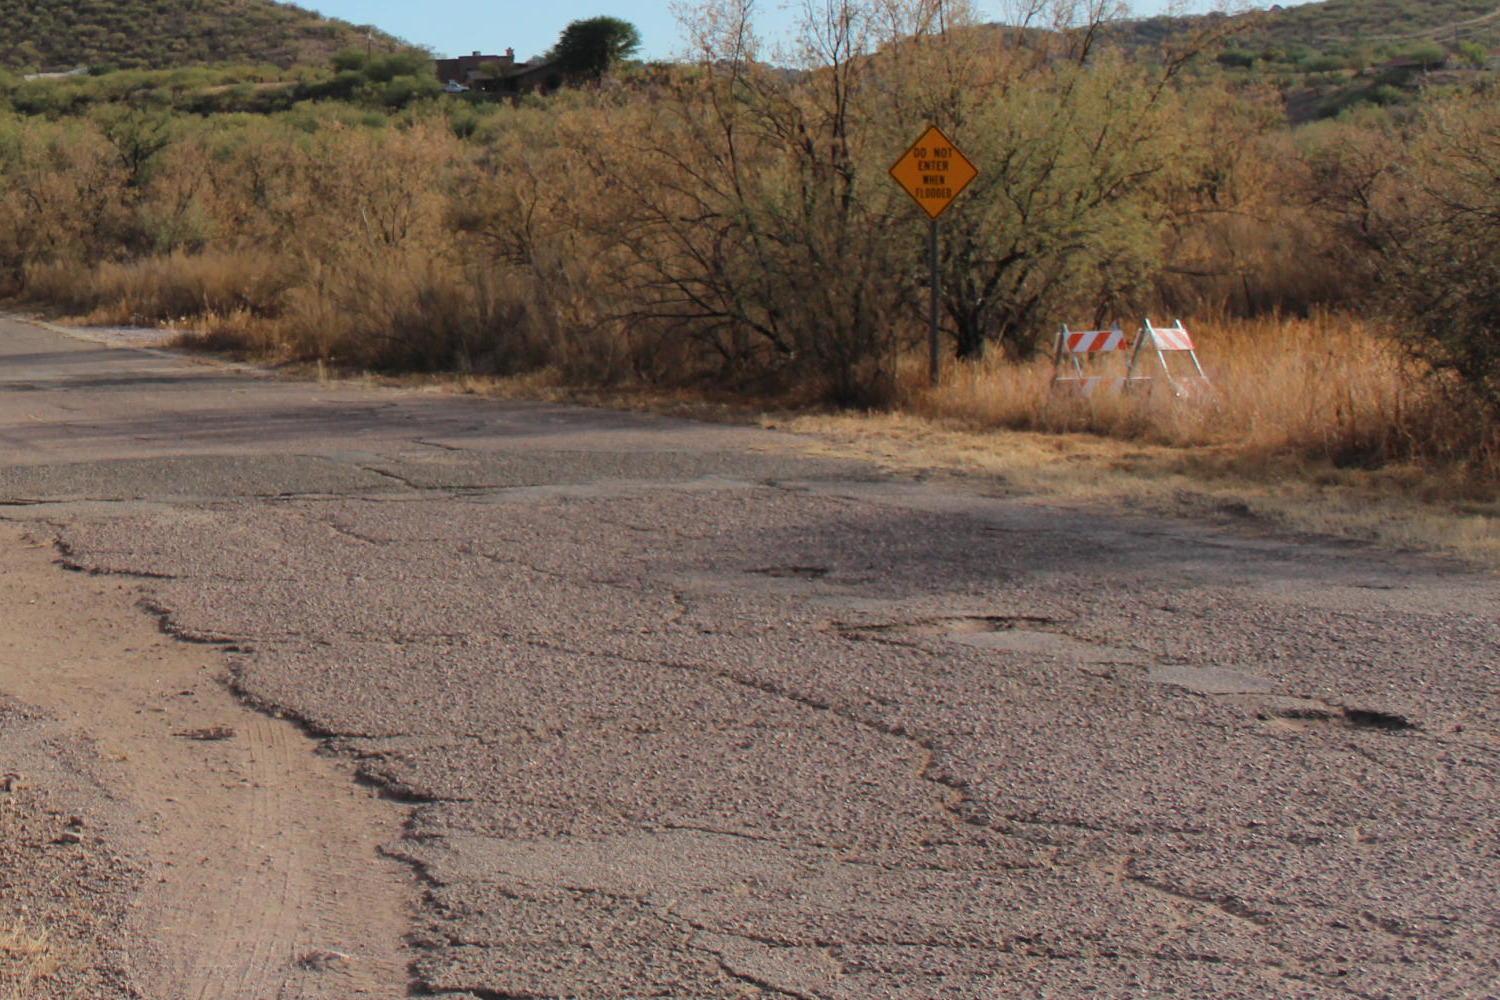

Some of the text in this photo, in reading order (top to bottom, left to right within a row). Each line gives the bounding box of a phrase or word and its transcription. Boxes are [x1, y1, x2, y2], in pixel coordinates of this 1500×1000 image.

[914, 148, 952, 158] DO NOT
[918, 161, 948, 171] ENTER
[923, 175, 945, 185] WHEN
[916, 188, 952, 198] FLOODED
